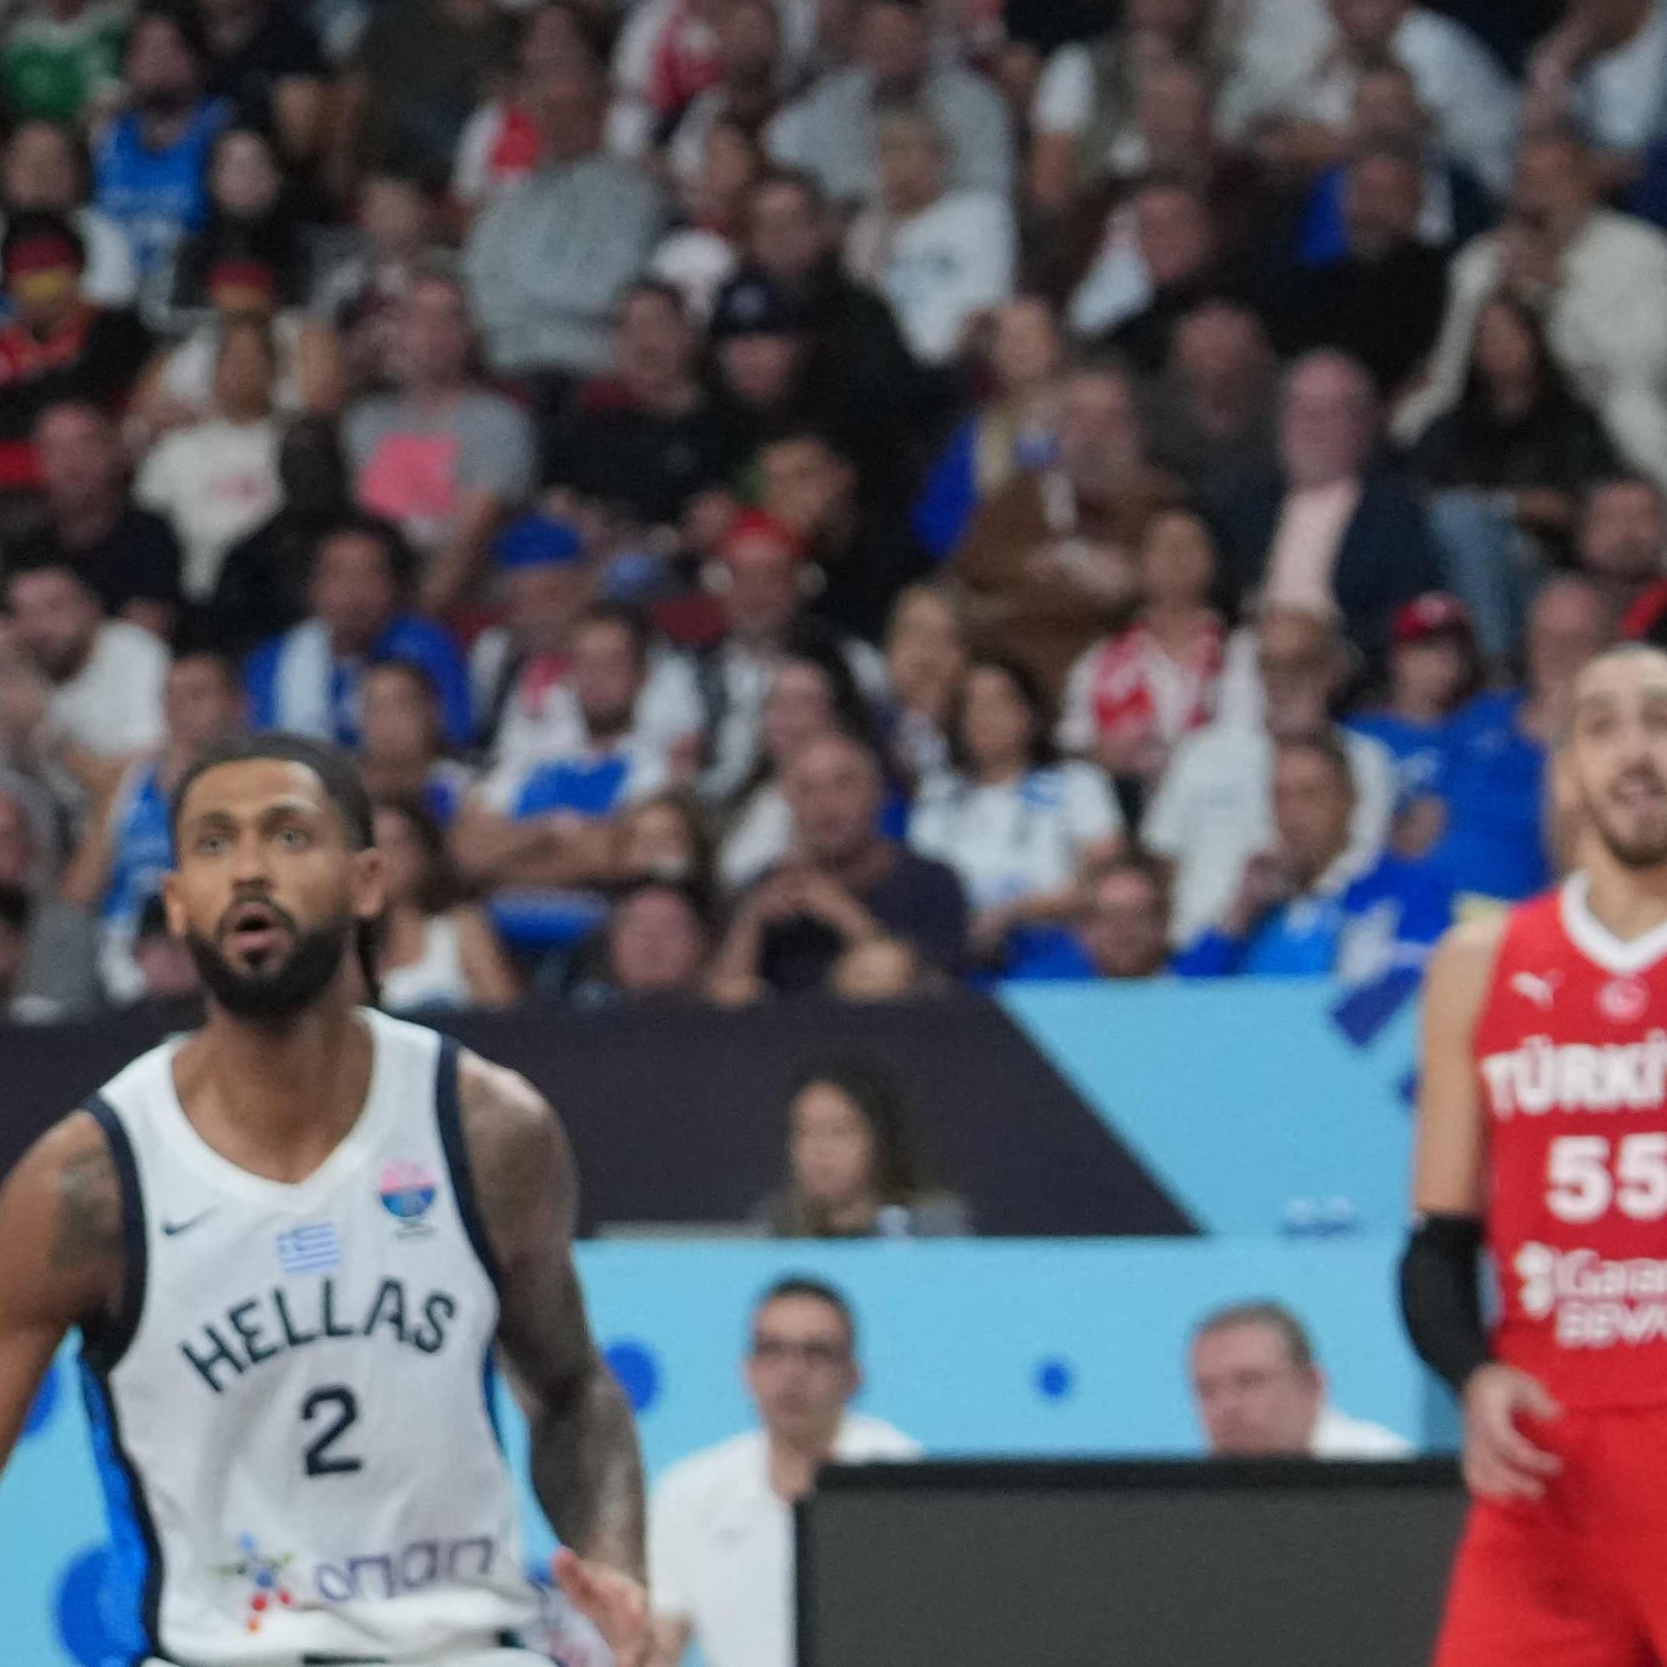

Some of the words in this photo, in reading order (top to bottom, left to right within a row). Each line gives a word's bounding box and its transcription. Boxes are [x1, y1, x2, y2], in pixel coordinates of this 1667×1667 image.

[1544, 1132, 1667, 1224] 55
[178, 1275, 456, 1394] HELLAS
[299, 1385, 362, 1479] 2
